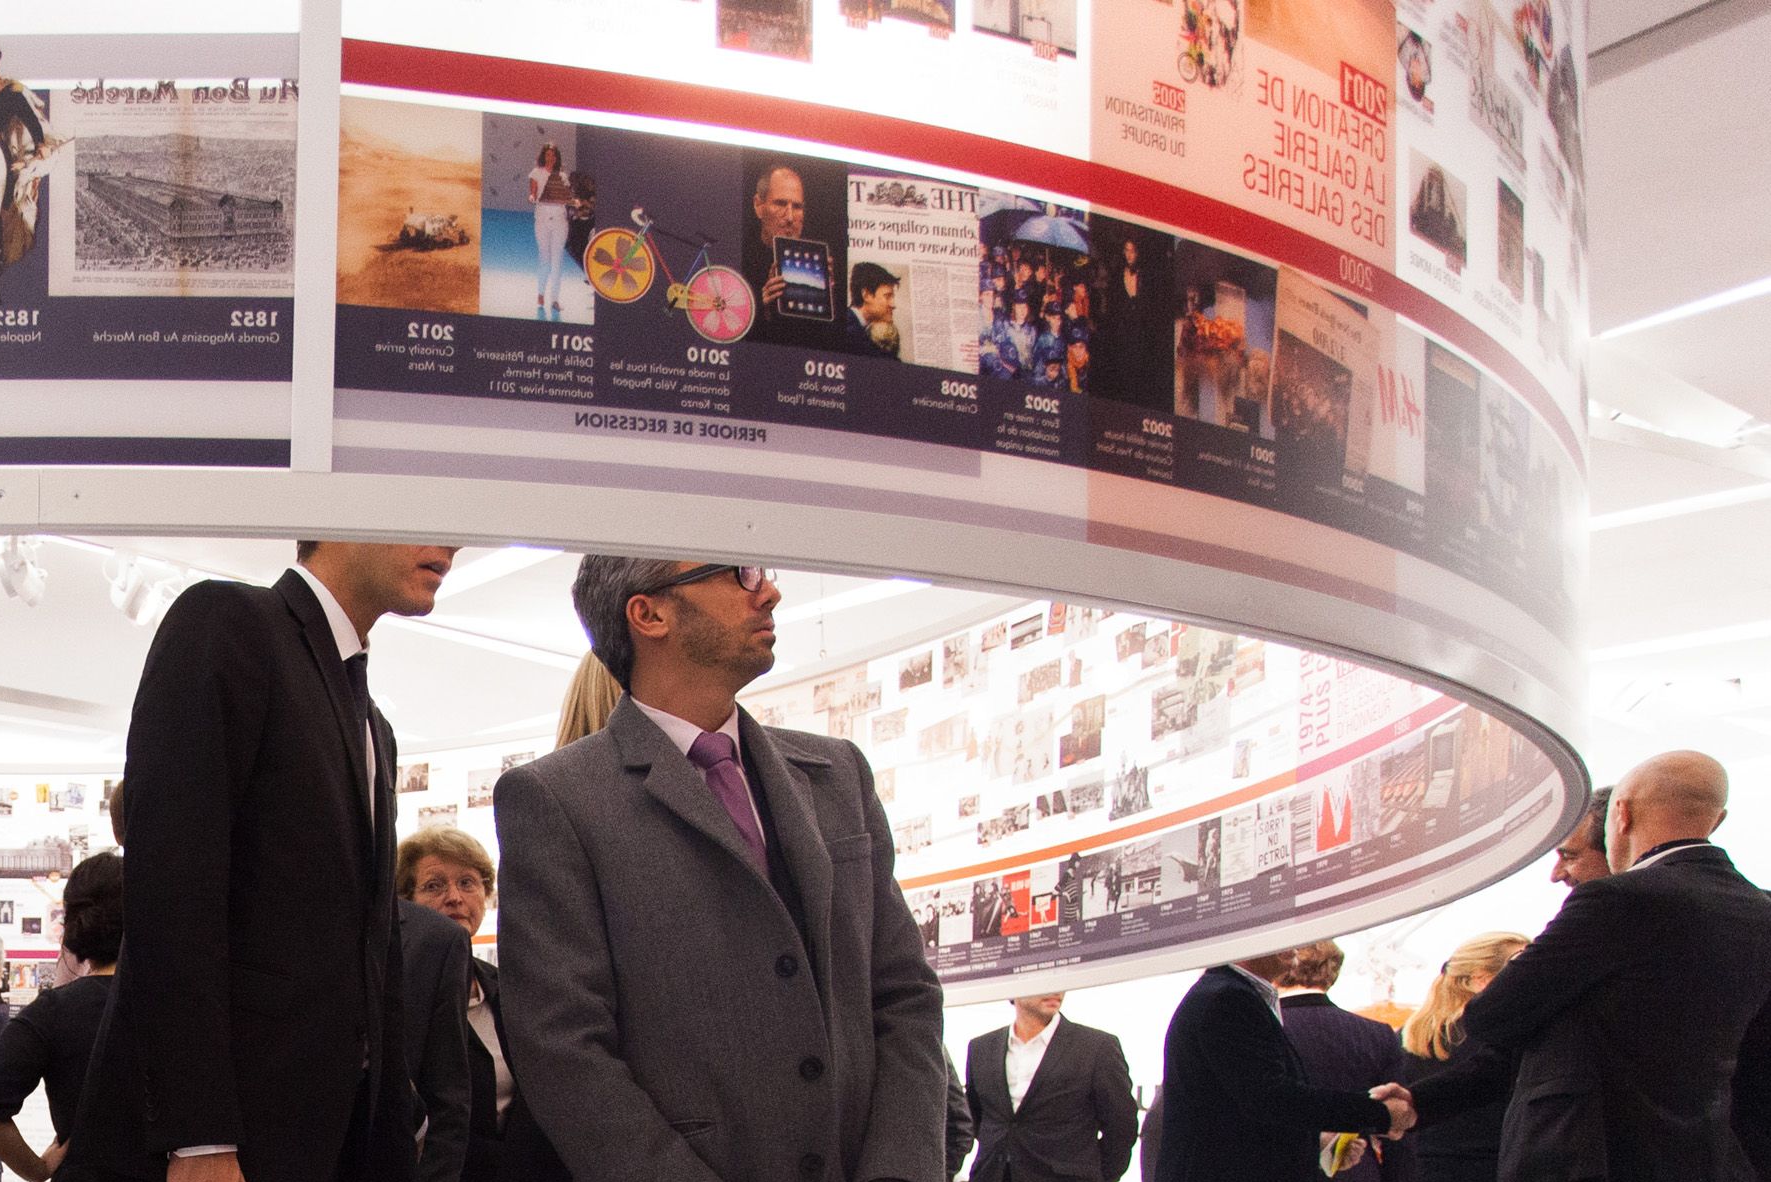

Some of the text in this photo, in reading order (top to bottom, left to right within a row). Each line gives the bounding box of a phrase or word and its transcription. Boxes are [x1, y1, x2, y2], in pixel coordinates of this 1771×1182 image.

[1316, 680, 1330, 748] PLUS
[1259, 817, 1286, 836] SORRY
[1268, 834, 1279, 846] NO
[1258, 844, 1290, 868] PETROL
